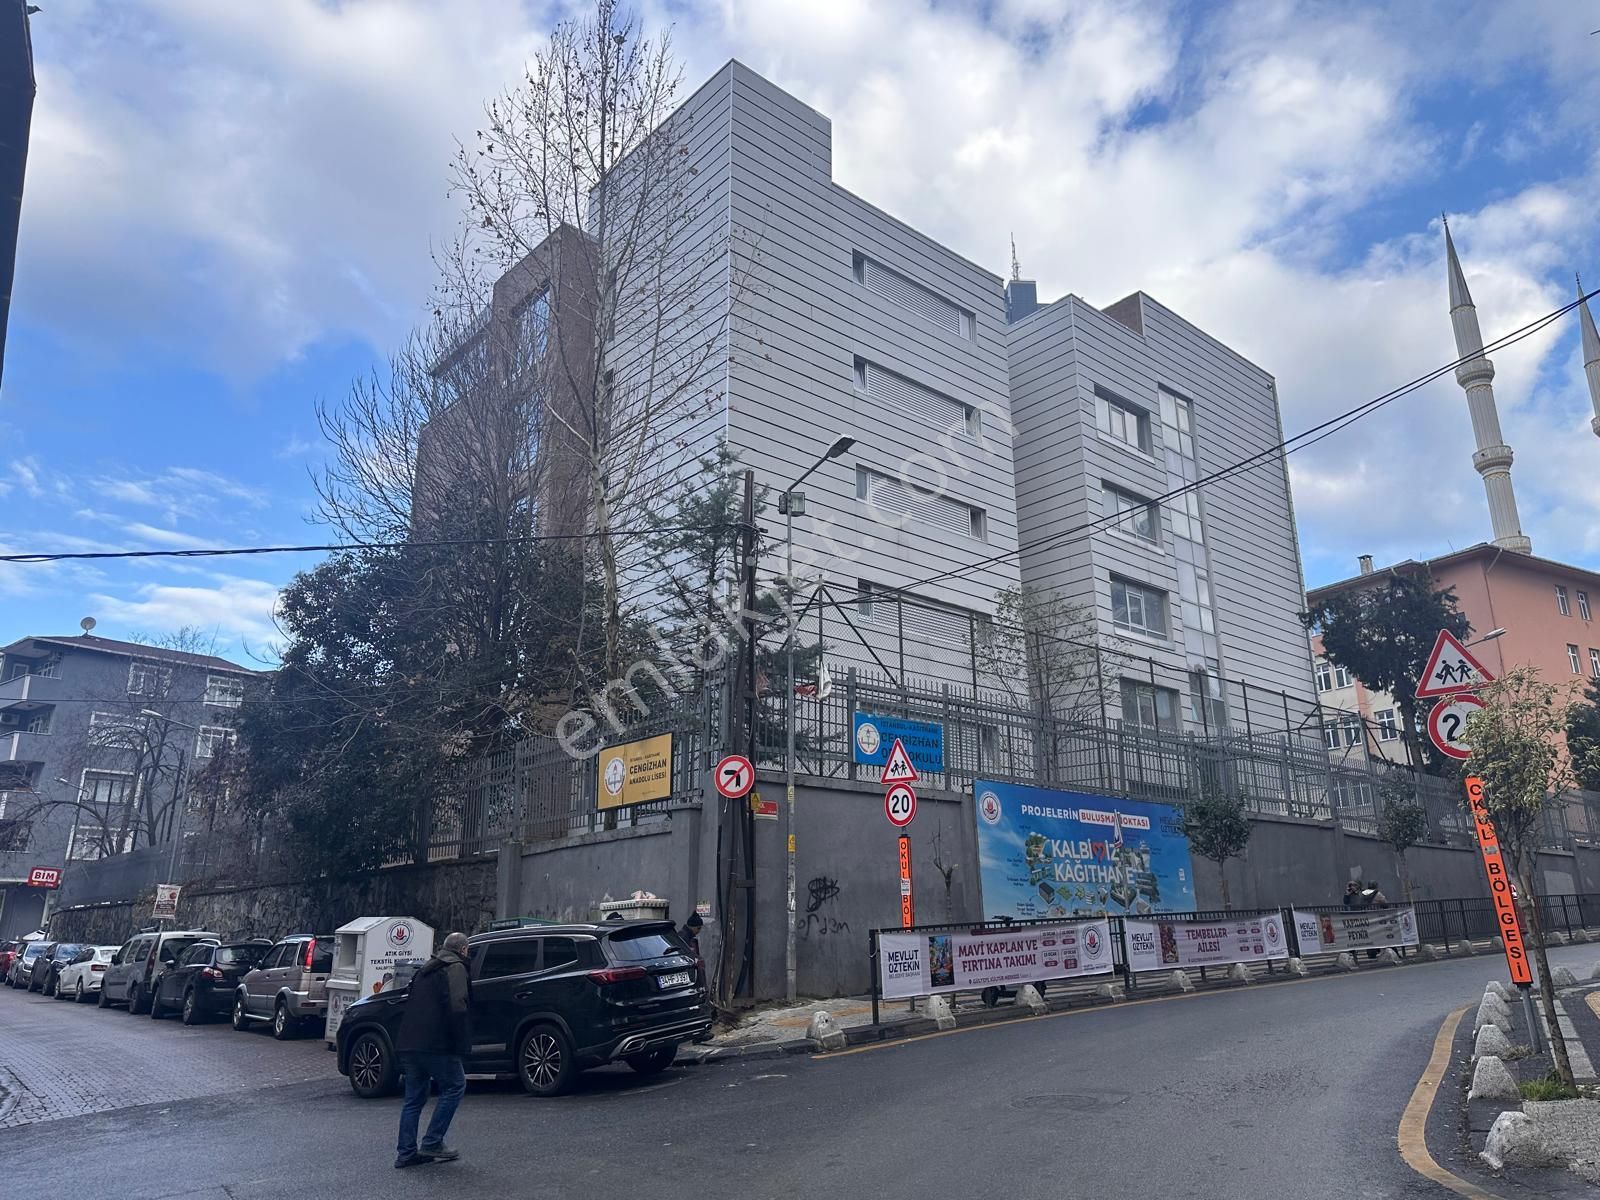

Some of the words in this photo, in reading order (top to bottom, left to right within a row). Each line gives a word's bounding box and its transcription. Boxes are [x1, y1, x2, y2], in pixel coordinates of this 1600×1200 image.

[881, 748, 941, 764] OOKULU
[629, 758, 667, 775] CENGİZHAN
[629, 775, 651, 785] ANADOLU
[892, 794, 910, 813] 20
[1021, 804, 1078, 819] PROJELERİN
[1489, 863, 1523, 977] BÖLGESİ
[1185, 927, 1228, 941] TEMBELLER
[958, 941, 985, 957] MAVİ
[987, 940, 1024, 955] KAPLAN
[1026, 939, 1038, 951] VE
[1197, 939, 1221, 953] AİLESİ
[962, 957, 1002, 973] FIRTINA
[1004, 954, 1037, 968] TAKIMI
